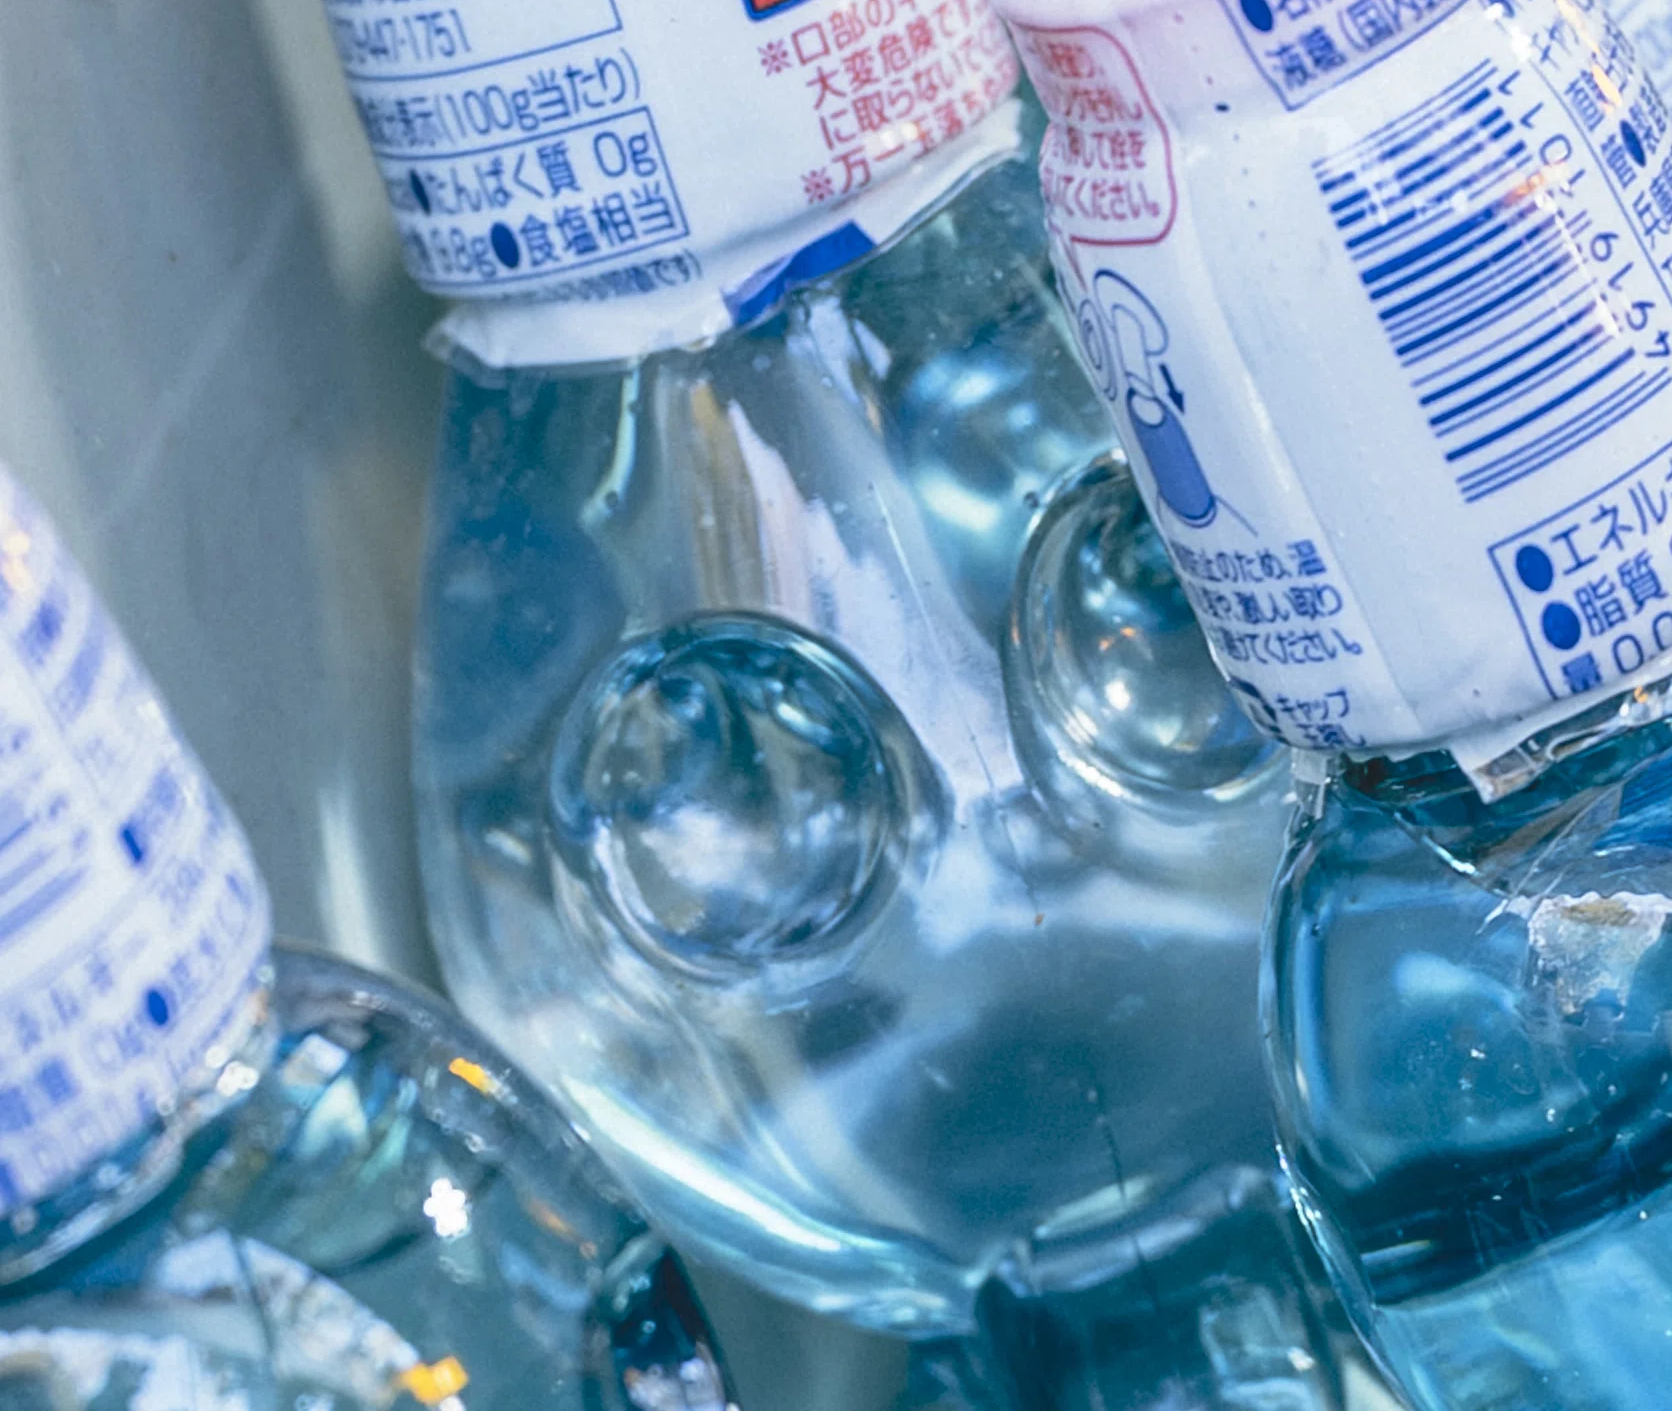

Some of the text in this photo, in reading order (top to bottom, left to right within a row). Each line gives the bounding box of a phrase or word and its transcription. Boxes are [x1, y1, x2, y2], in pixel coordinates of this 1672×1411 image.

[593, 130, 659, 180] 0g
[519, 181, 677, 269] 食塩相当
[1573, 548, 1670, 638] 脂質
